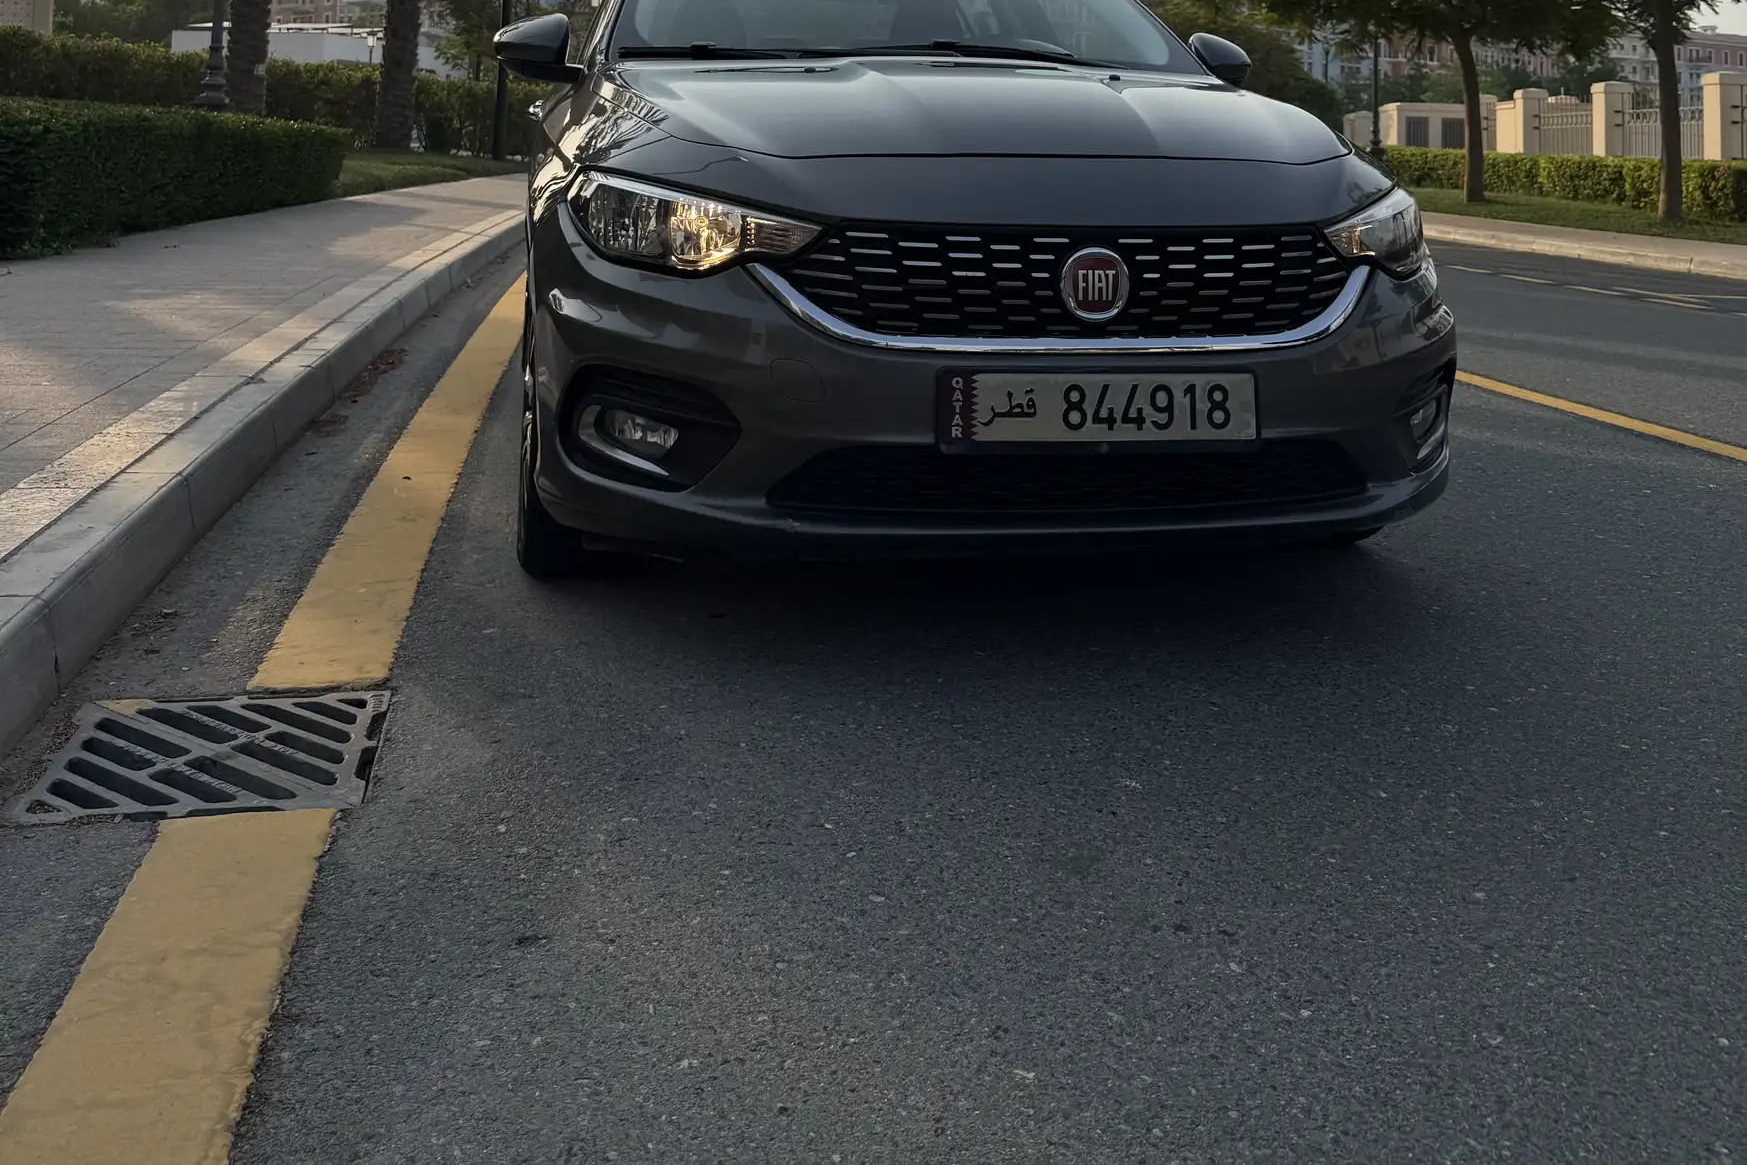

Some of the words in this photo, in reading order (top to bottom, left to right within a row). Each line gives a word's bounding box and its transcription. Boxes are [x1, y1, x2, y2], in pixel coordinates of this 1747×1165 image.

[1078, 269, 1116, 301] FIAT
[951, 377, 964, 438] QATAR
[976, 387, 1037, 427] قطر
[1061, 383, 1231, 431] 844918
